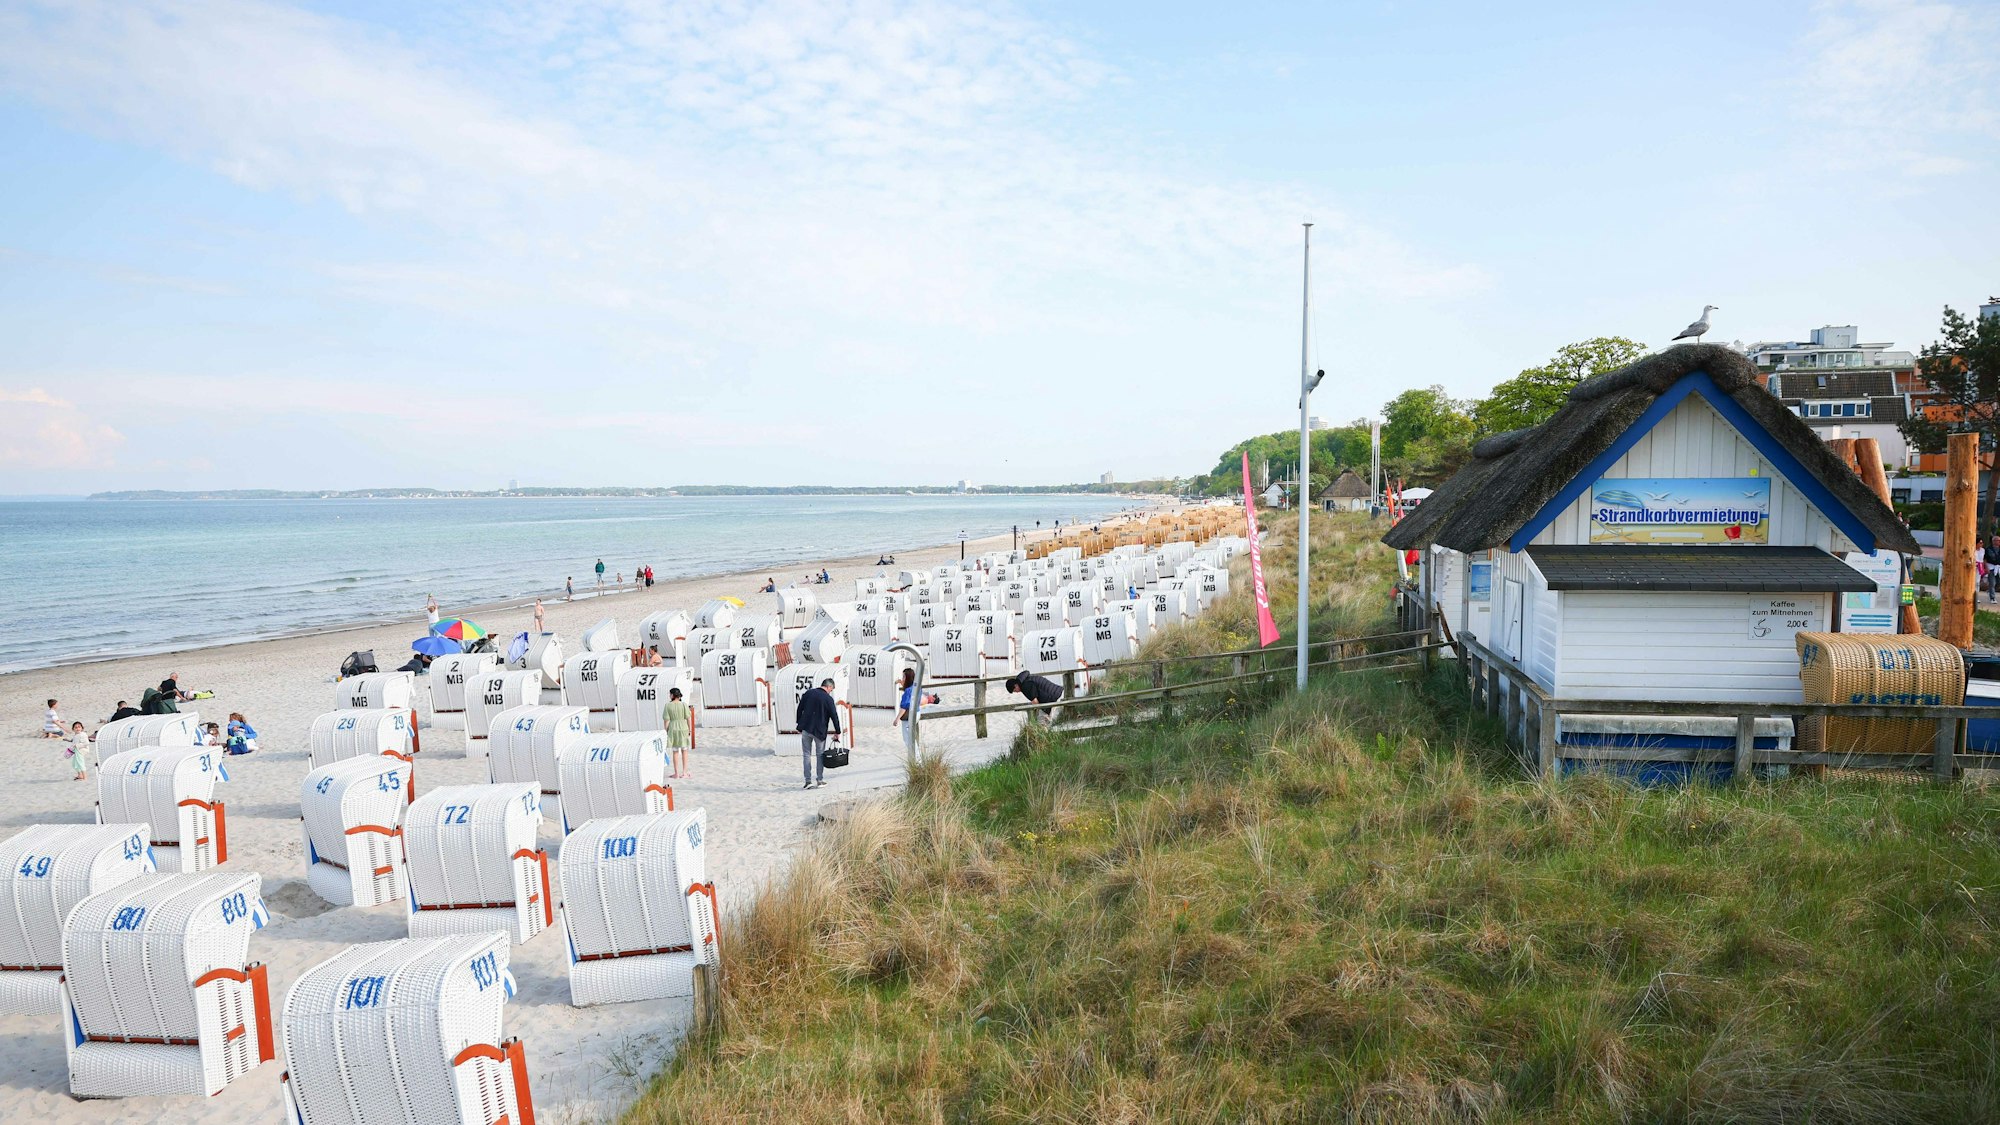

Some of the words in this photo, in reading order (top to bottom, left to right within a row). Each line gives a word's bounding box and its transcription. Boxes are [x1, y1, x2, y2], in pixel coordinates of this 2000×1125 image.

[1599, 508, 1759, 524] Strandkorbvermietung
[1172, 582, 1183, 590] 77
[1154, 595, 1166, 603] 76
[1037, 601, 1049, 610] 59
[921, 608, 931, 617] 41
[1037, 613, 1050, 621] MB
[863, 620, 876, 629] 40
[979, 616, 993, 625] 58
[1095, 618, 1110, 628] 93
[1787, 620, 1802, 628] 2,00
[651, 622, 657, 632] 5
[742, 628, 754, 637] 22
[863, 629, 877, 637] MB
[946, 630, 961, 640] 57
[1096, 631, 1112, 640] MB
[701, 634, 715, 645] 21
[742, 639, 756, 647] MB
[1040, 636, 1056, 648] 73
[946, 643, 962, 652] MB
[720, 654, 736, 666] 38
[858, 654, 876, 665] 56
[1040, 651, 1058, 662] MB
[450, 661, 460, 672] 2
[520, 658, 527, 668] 3
[582, 659, 598, 671] 20
[581, 672, 598, 682] MB
[719, 666, 737, 677] MB
[858, 667, 876, 677] MB
[447, 675, 464, 684] MB
[639, 674, 658, 687] 37
[795, 676, 814, 690] 55
[358, 681, 365, 693] 1
[488, 679, 503, 692] 19
[484, 694, 504, 705] MB
[637, 689, 656, 701] MB
[352, 697, 368, 707] MB
[338, 718, 356, 730] 29
[394, 715, 404, 730] 29
[515, 718, 534, 731] 43
[569, 716, 581, 730] 43
[590, 747, 610, 762] 70
[130, 760, 152, 775] 31
[200, 755, 212, 772] 31
[316, 776, 333, 794] 45
[378, 771, 400, 792] 45
[522, 791, 536, 816] 72
[444, 805, 470, 825] 72
[124, 834, 143, 860] 49
[602, 836, 637, 859] 100
[20, 855, 51, 878] 49
[221, 893, 247, 925] 80
[113, 907, 146, 931] 80
[470, 951, 500, 991] 101
[346, 975, 386, 1010] 101
